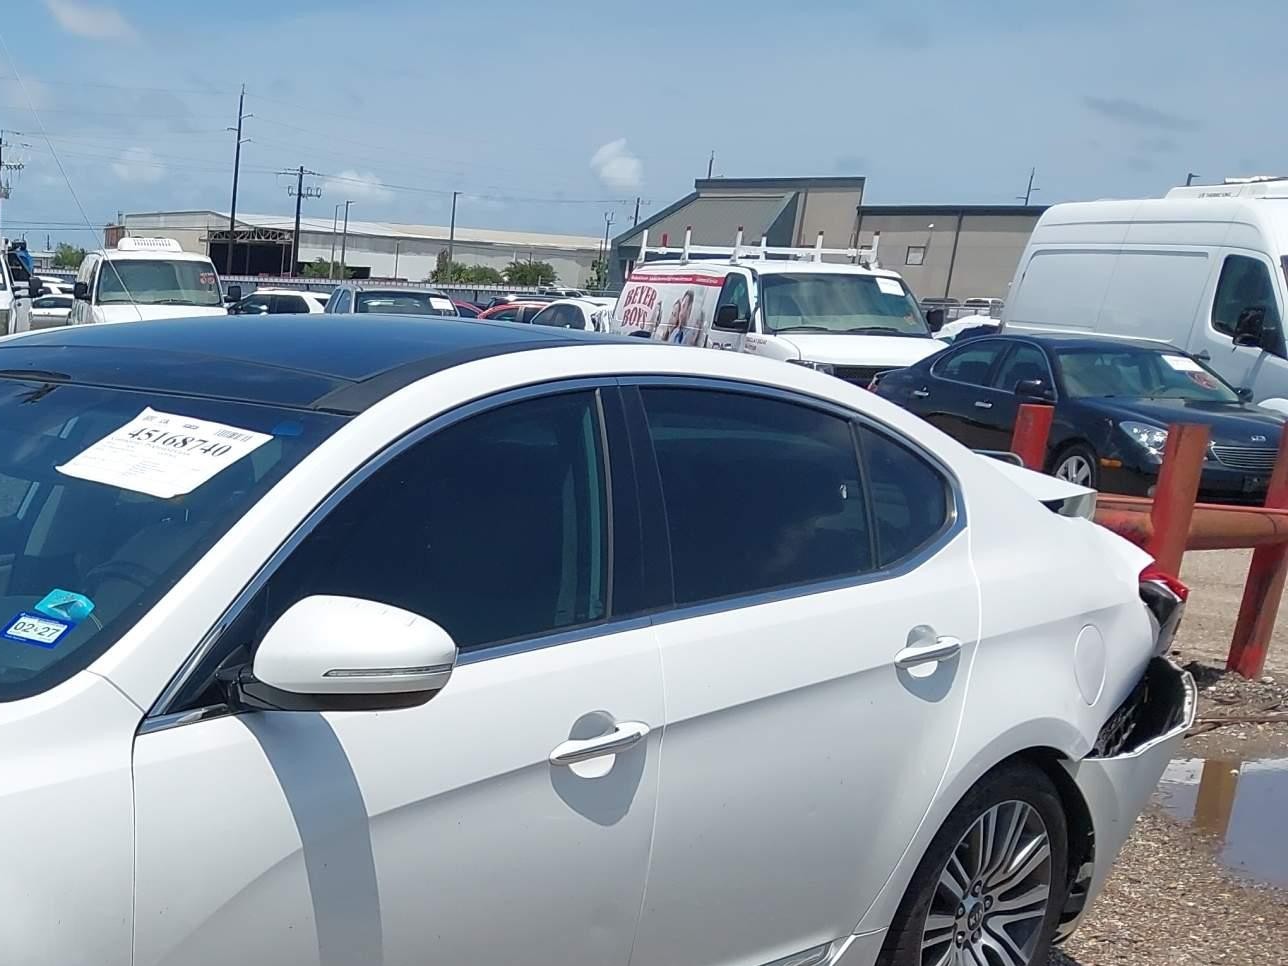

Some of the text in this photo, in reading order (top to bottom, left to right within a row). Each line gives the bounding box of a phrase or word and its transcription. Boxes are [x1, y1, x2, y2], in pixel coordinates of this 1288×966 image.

[624, 285, 658, 310] BEYER
[621, 304, 649, 330] BOYS
[128, 428, 233, 457] 45168740
